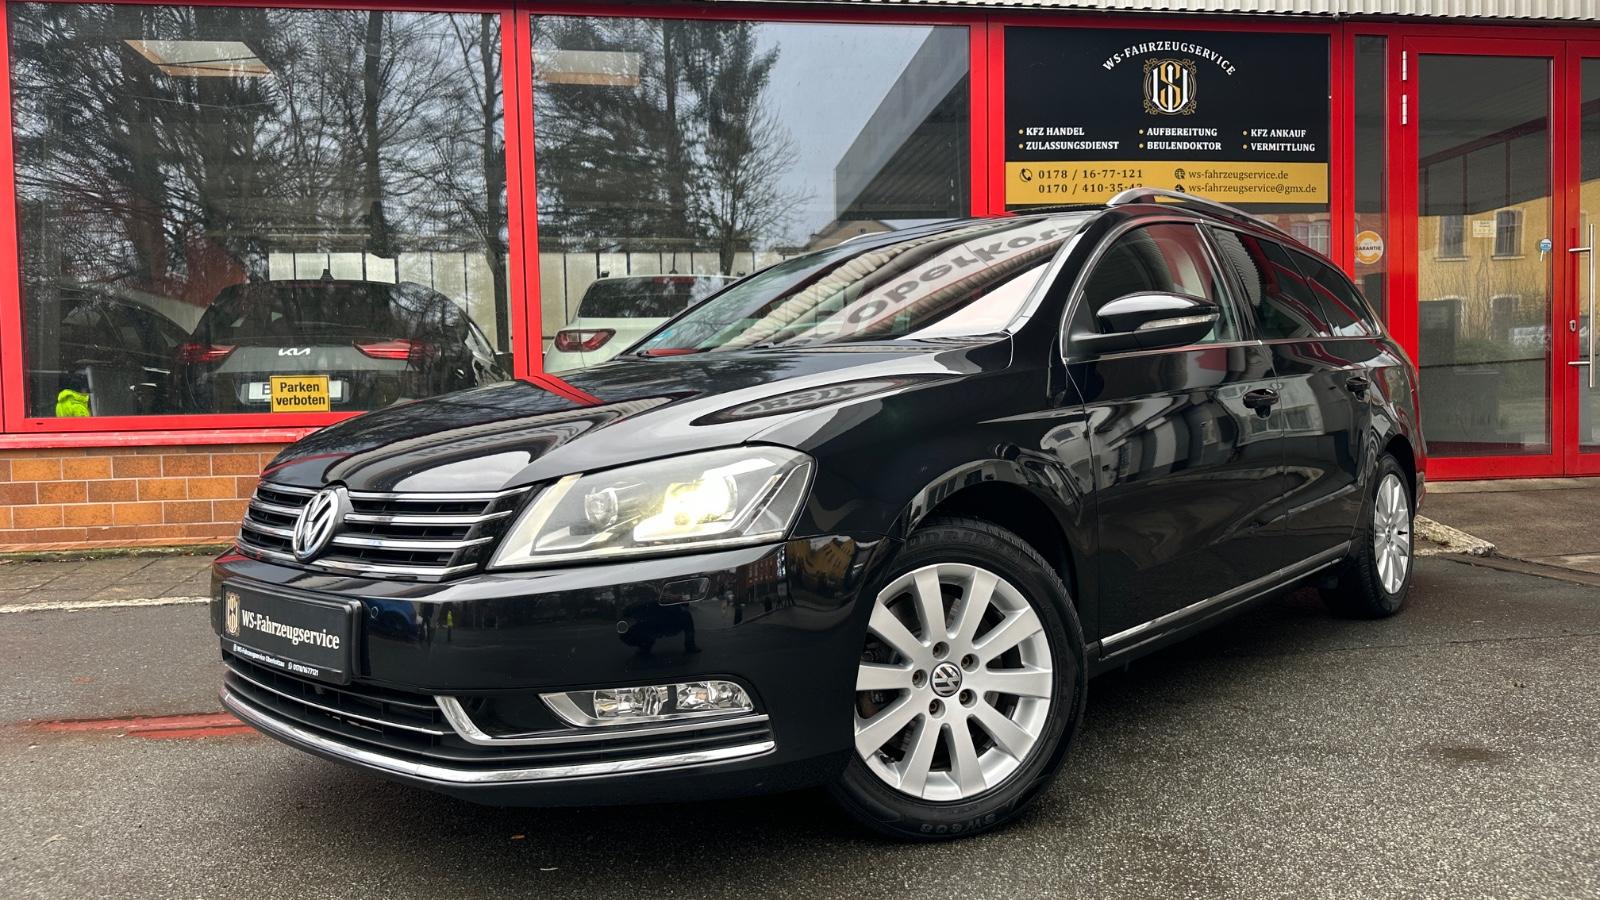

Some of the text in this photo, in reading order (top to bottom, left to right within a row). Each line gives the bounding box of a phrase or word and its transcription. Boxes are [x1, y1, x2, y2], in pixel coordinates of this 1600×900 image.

[1102, 41, 1236, 76] WS-FAHRZEUGSERVICE
[1026, 127, 1085, 136] KFZ HANDEL
[1146, 127, 1218, 137] AUFBEREITUNG
[1250, 129, 1307, 138] KFZ ANKAUF
[1026, 141, 1120, 150] ZULASSUNGSDIENST
[1147, 141, 1222, 151] BEULENDOKTOR
[1250, 142, 1316, 152] VERMITTLUNG
[1038, 170, 1068, 179] 0178
[1082, 169, 1143, 179] 16-77-121
[1188, 168, 1289, 181] ws-fahrzeugservice.de
[1038, 184, 1068, 193] 0170
[1188, 183, 1317, 195] ws-fahrzeugservice@gmx.de
[280, 382, 320, 392] Parken
[275, 396, 326, 406] verboten
[241, 608, 340, 650] WS-Fahrzeugservice
